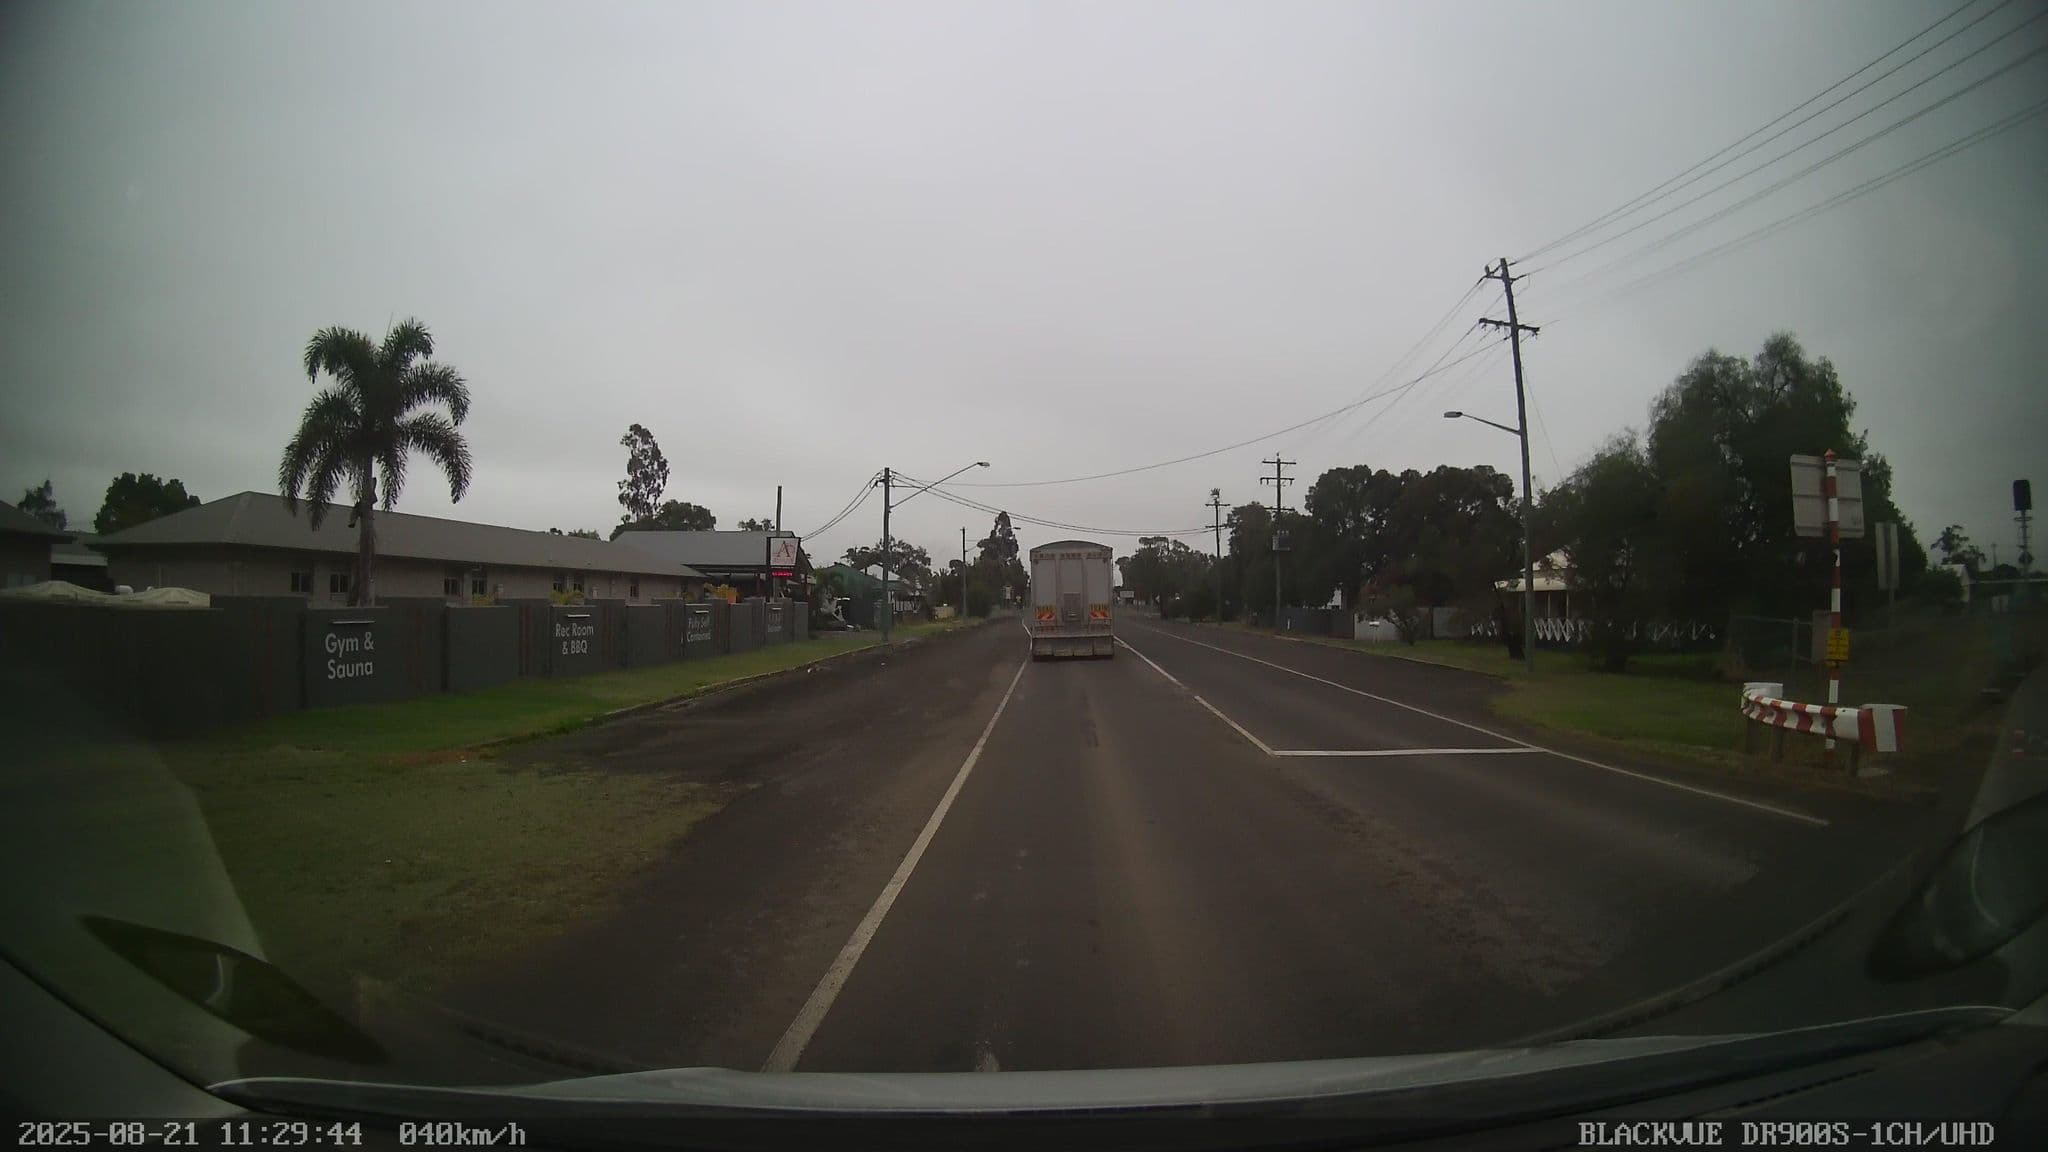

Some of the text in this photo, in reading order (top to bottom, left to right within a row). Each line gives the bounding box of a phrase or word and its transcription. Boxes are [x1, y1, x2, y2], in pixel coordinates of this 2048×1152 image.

[555, 622, 594, 638] Rec Room
[325, 631, 375, 658] Gym &
[561, 639, 588, 655] & BBQ
[327, 658, 373, 680] Sauna
